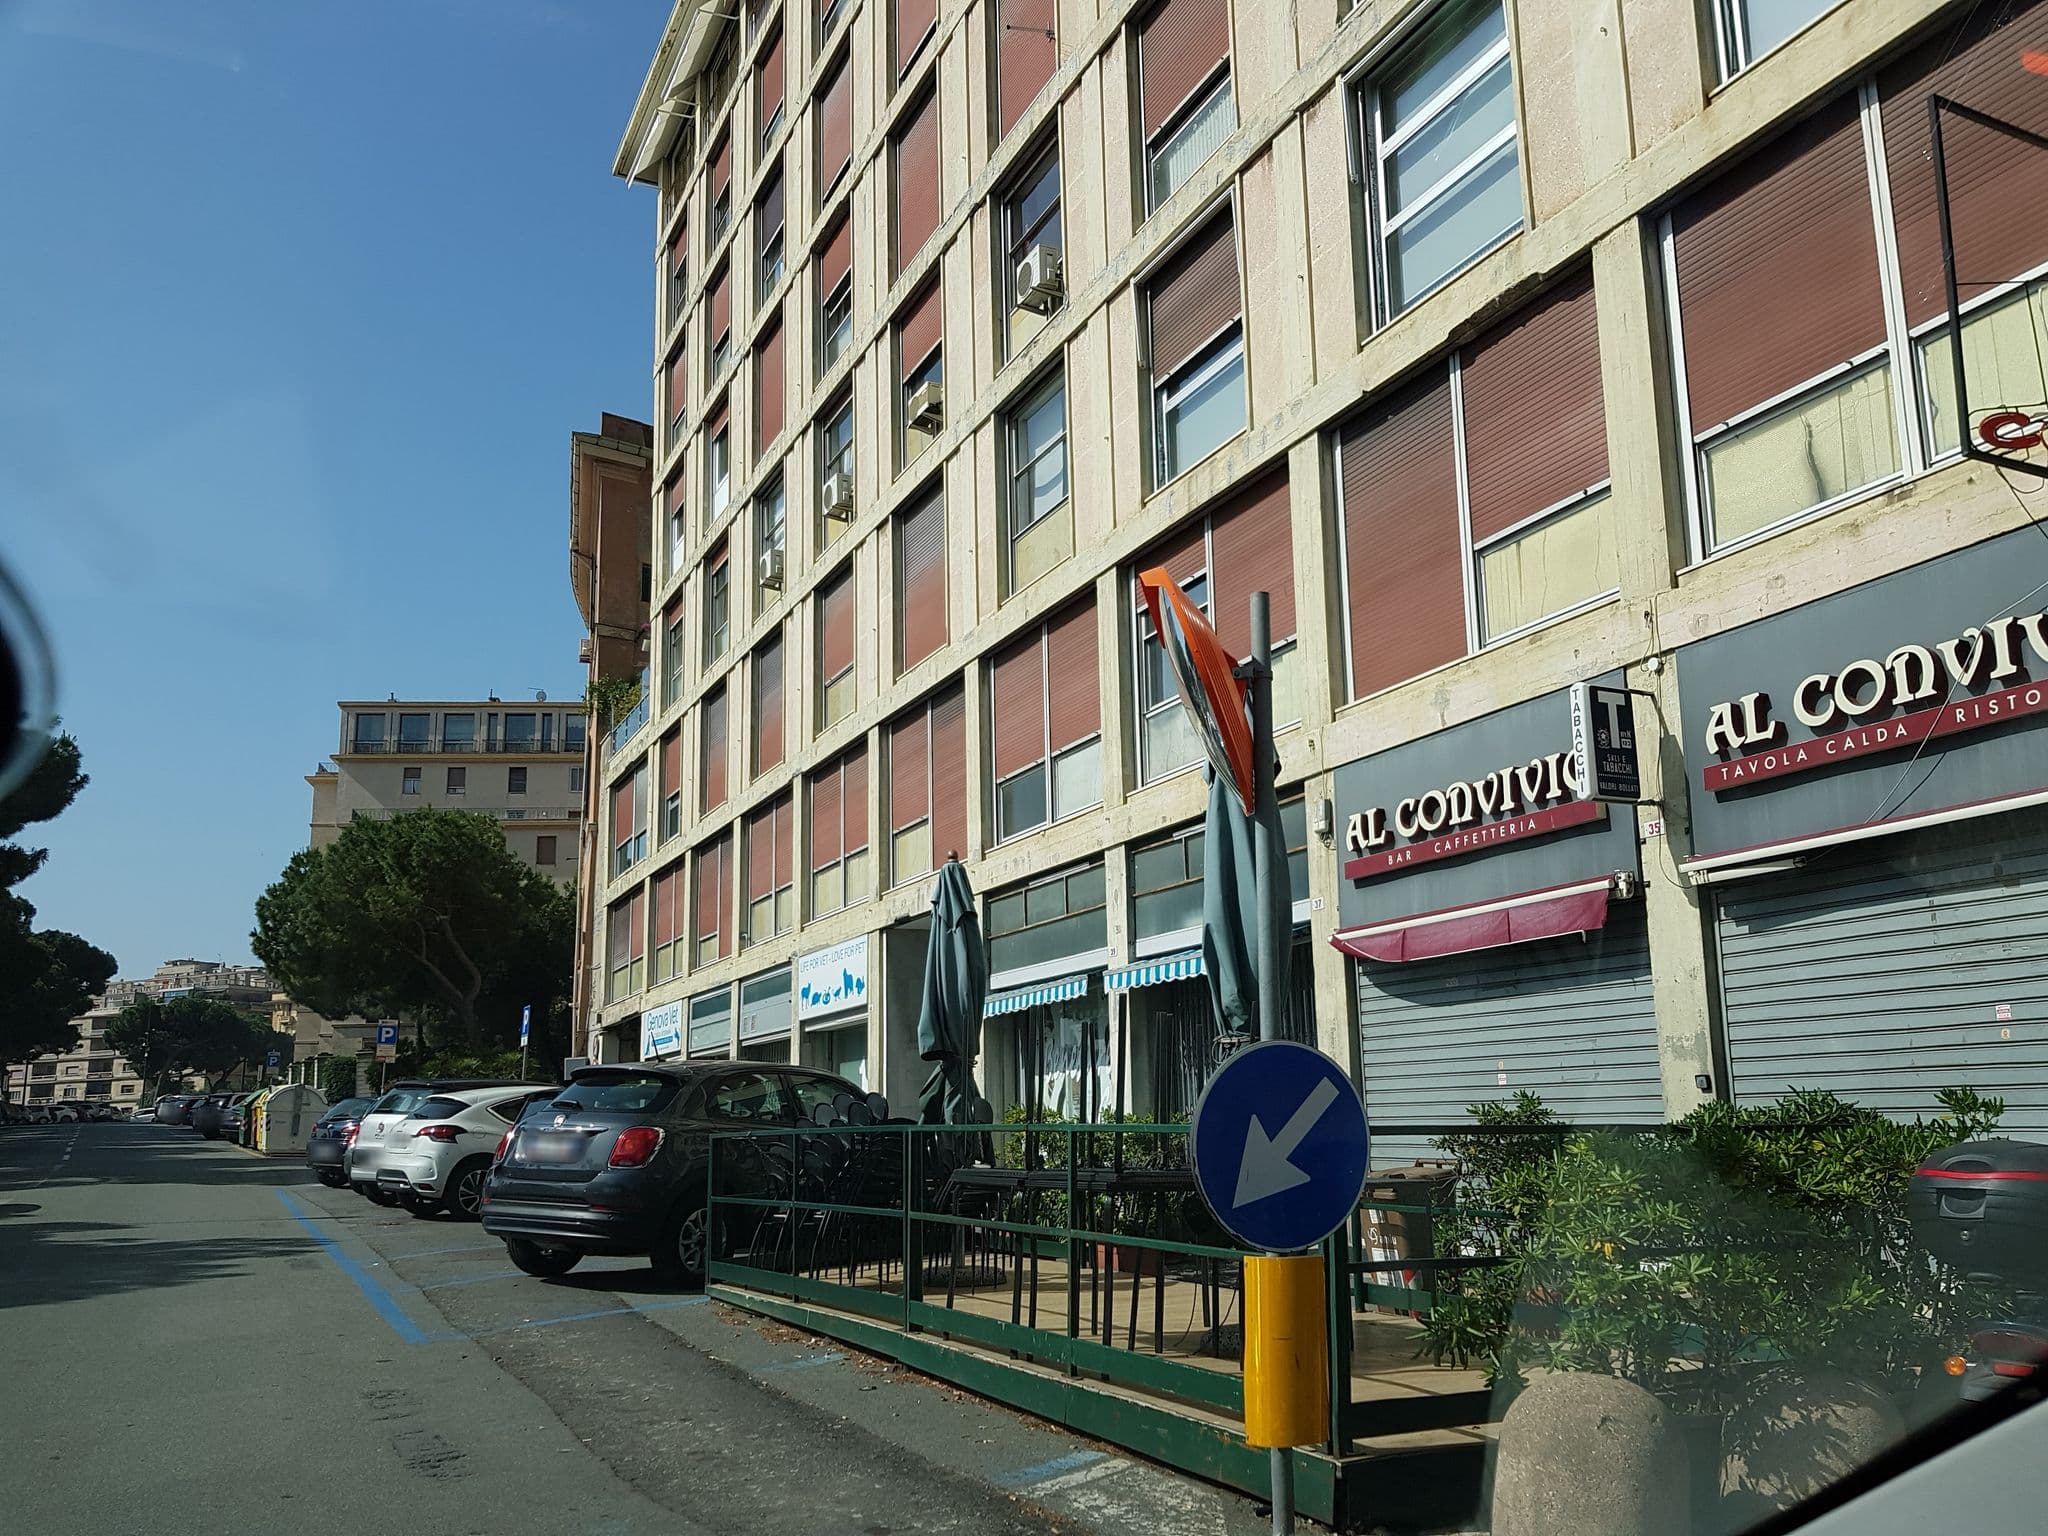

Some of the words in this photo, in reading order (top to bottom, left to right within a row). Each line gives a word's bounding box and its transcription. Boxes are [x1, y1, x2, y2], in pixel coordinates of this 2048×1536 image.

[1980, 411, 2048, 450] C
[1597, 690, 1626, 750] T
[1705, 691, 1776, 755] AL
[1721, 747, 1808, 781] TAVOLA
[1825, 726, 1908, 754] CALDA
[1956, 689, 2041, 724] RISTO
[1572, 688, 1585, 793] TABACCHI
[1603, 761, 1632, 775] TABACCHI
[1345, 807, 1386, 852] AL
[1388, 850, 1412, 866] BAR
[1434, 818, 1536, 854] CAFFETTERIA
[1648, 822, 1661, 835] 35
[1314, 899, 1322, 909] 37
[855, 941, 866, 954] PET
[381, 1027, 394, 1042] P
[647, 1011, 669, 1032] Genova
[669, 1005, 680, 1025] Vet
[269, 1056, 278, 1066] P
